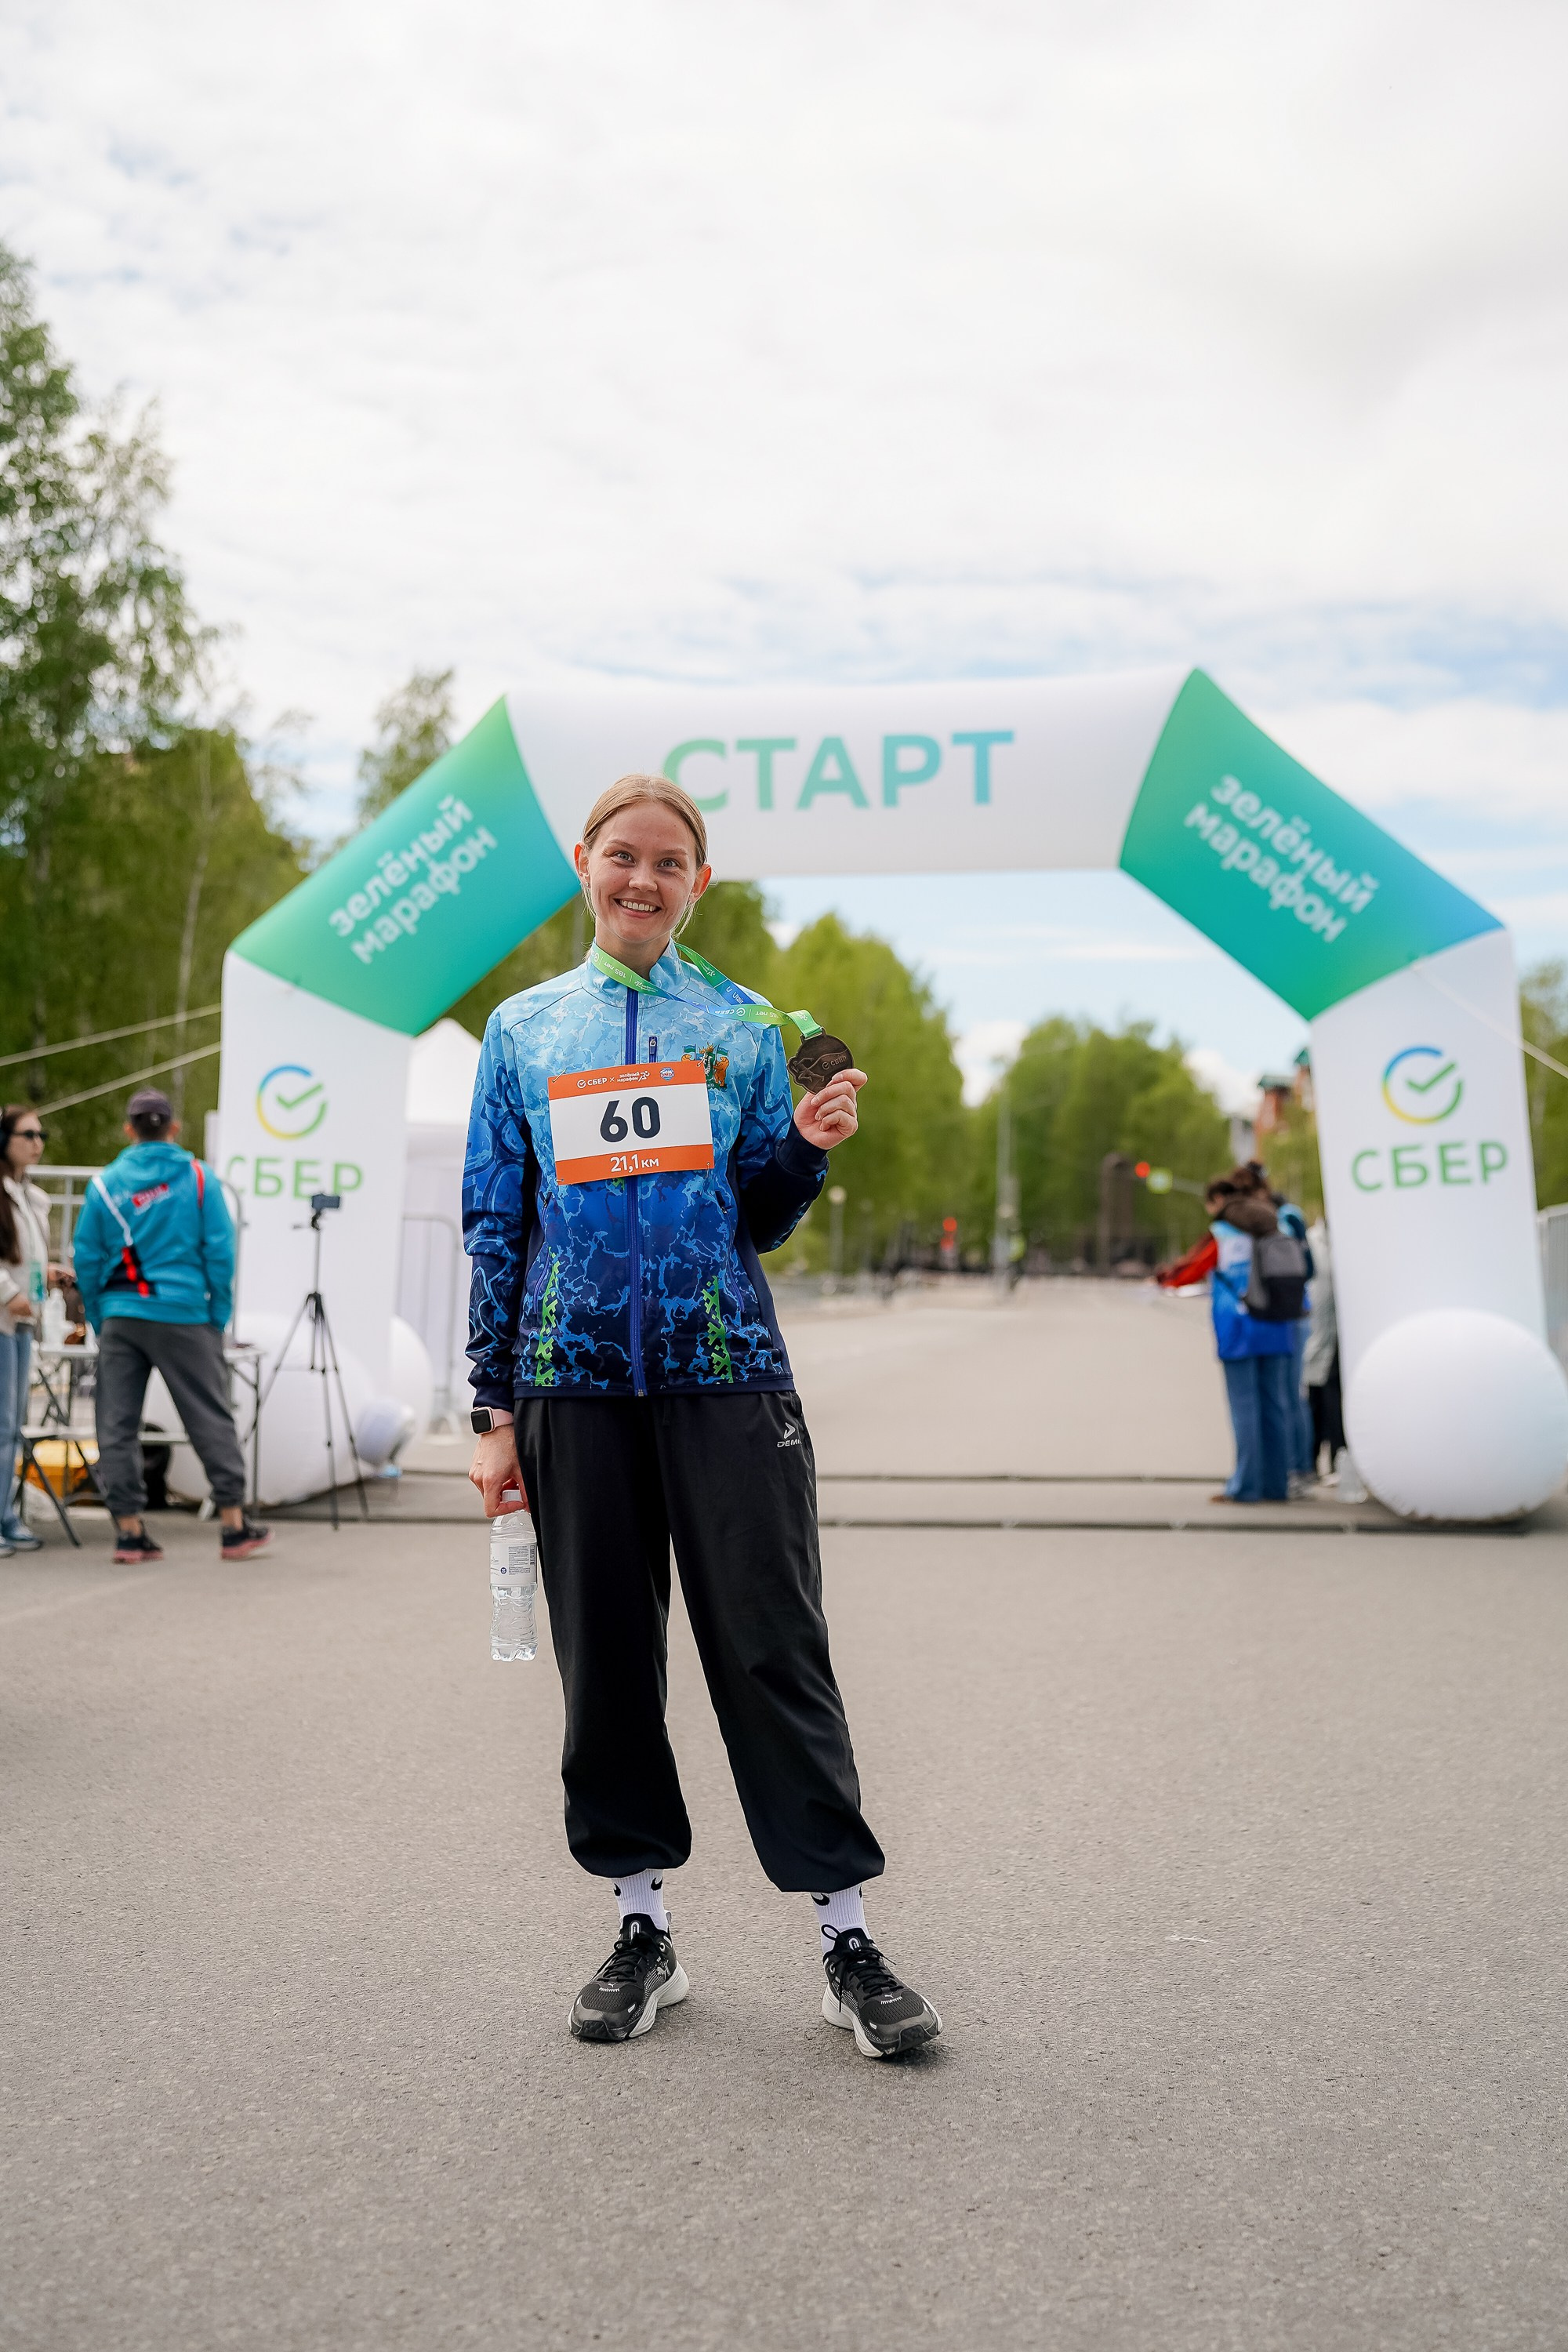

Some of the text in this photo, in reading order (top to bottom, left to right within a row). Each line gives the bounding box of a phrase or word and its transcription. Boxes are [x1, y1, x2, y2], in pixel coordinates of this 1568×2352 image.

[662, 730, 1014, 813] СТАРТ
[328, 793, 474, 938] зелёный
[1184, 802, 1347, 942] марафон
[1210, 774, 1379, 914] зелёный
[350, 826, 498, 964] марафон
[614, 968, 626, 978] 185
[587, 1077, 608, 1086] СБЕР
[600, 1096, 661, 1142] 60
[610, 1153, 639, 1173] 21,1
[1351, 1141, 1508, 1193] СБЕР
